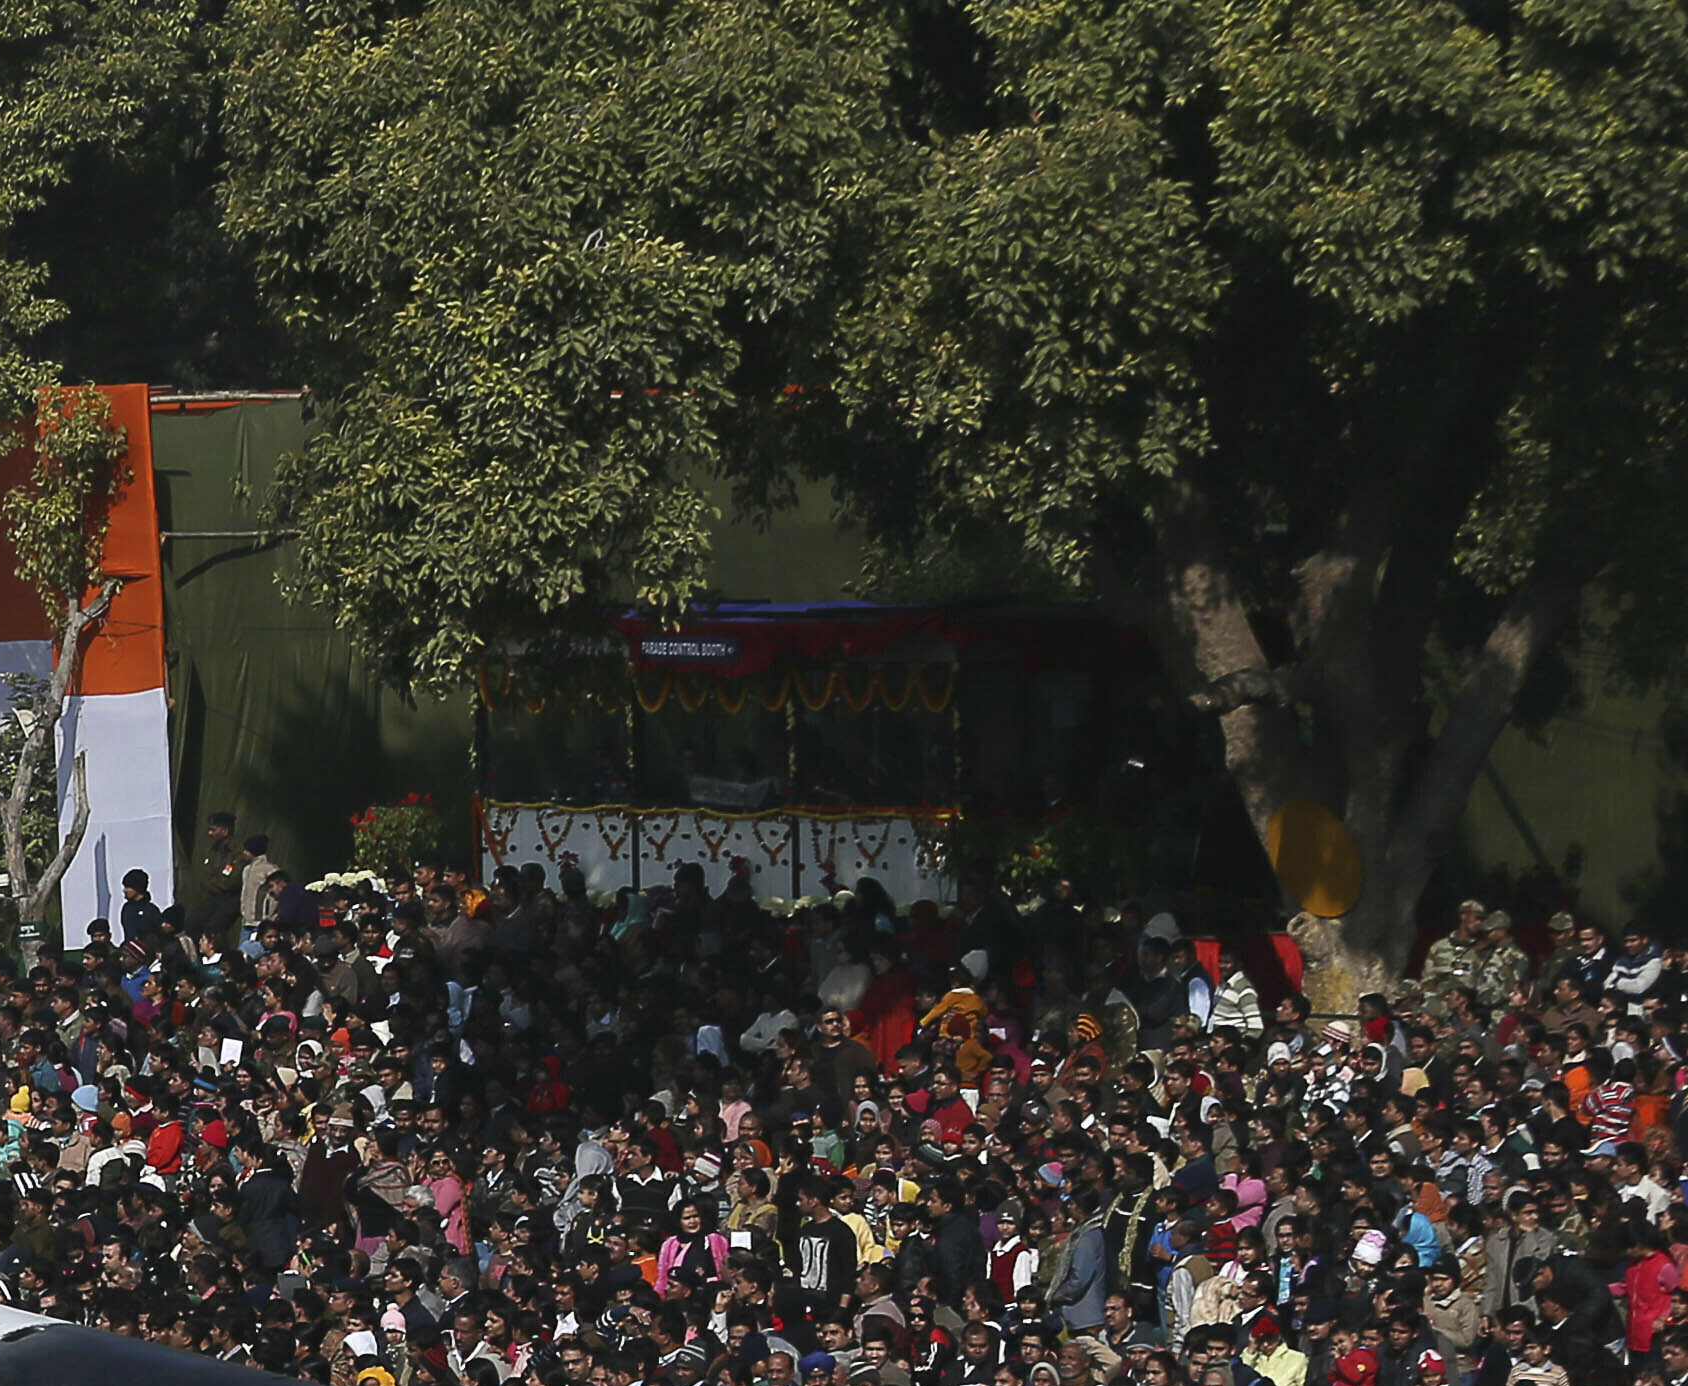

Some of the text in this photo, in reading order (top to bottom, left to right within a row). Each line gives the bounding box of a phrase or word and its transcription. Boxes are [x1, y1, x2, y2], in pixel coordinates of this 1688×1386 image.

[641, 641, 726, 656] PARADE CONTROL BOOTH
